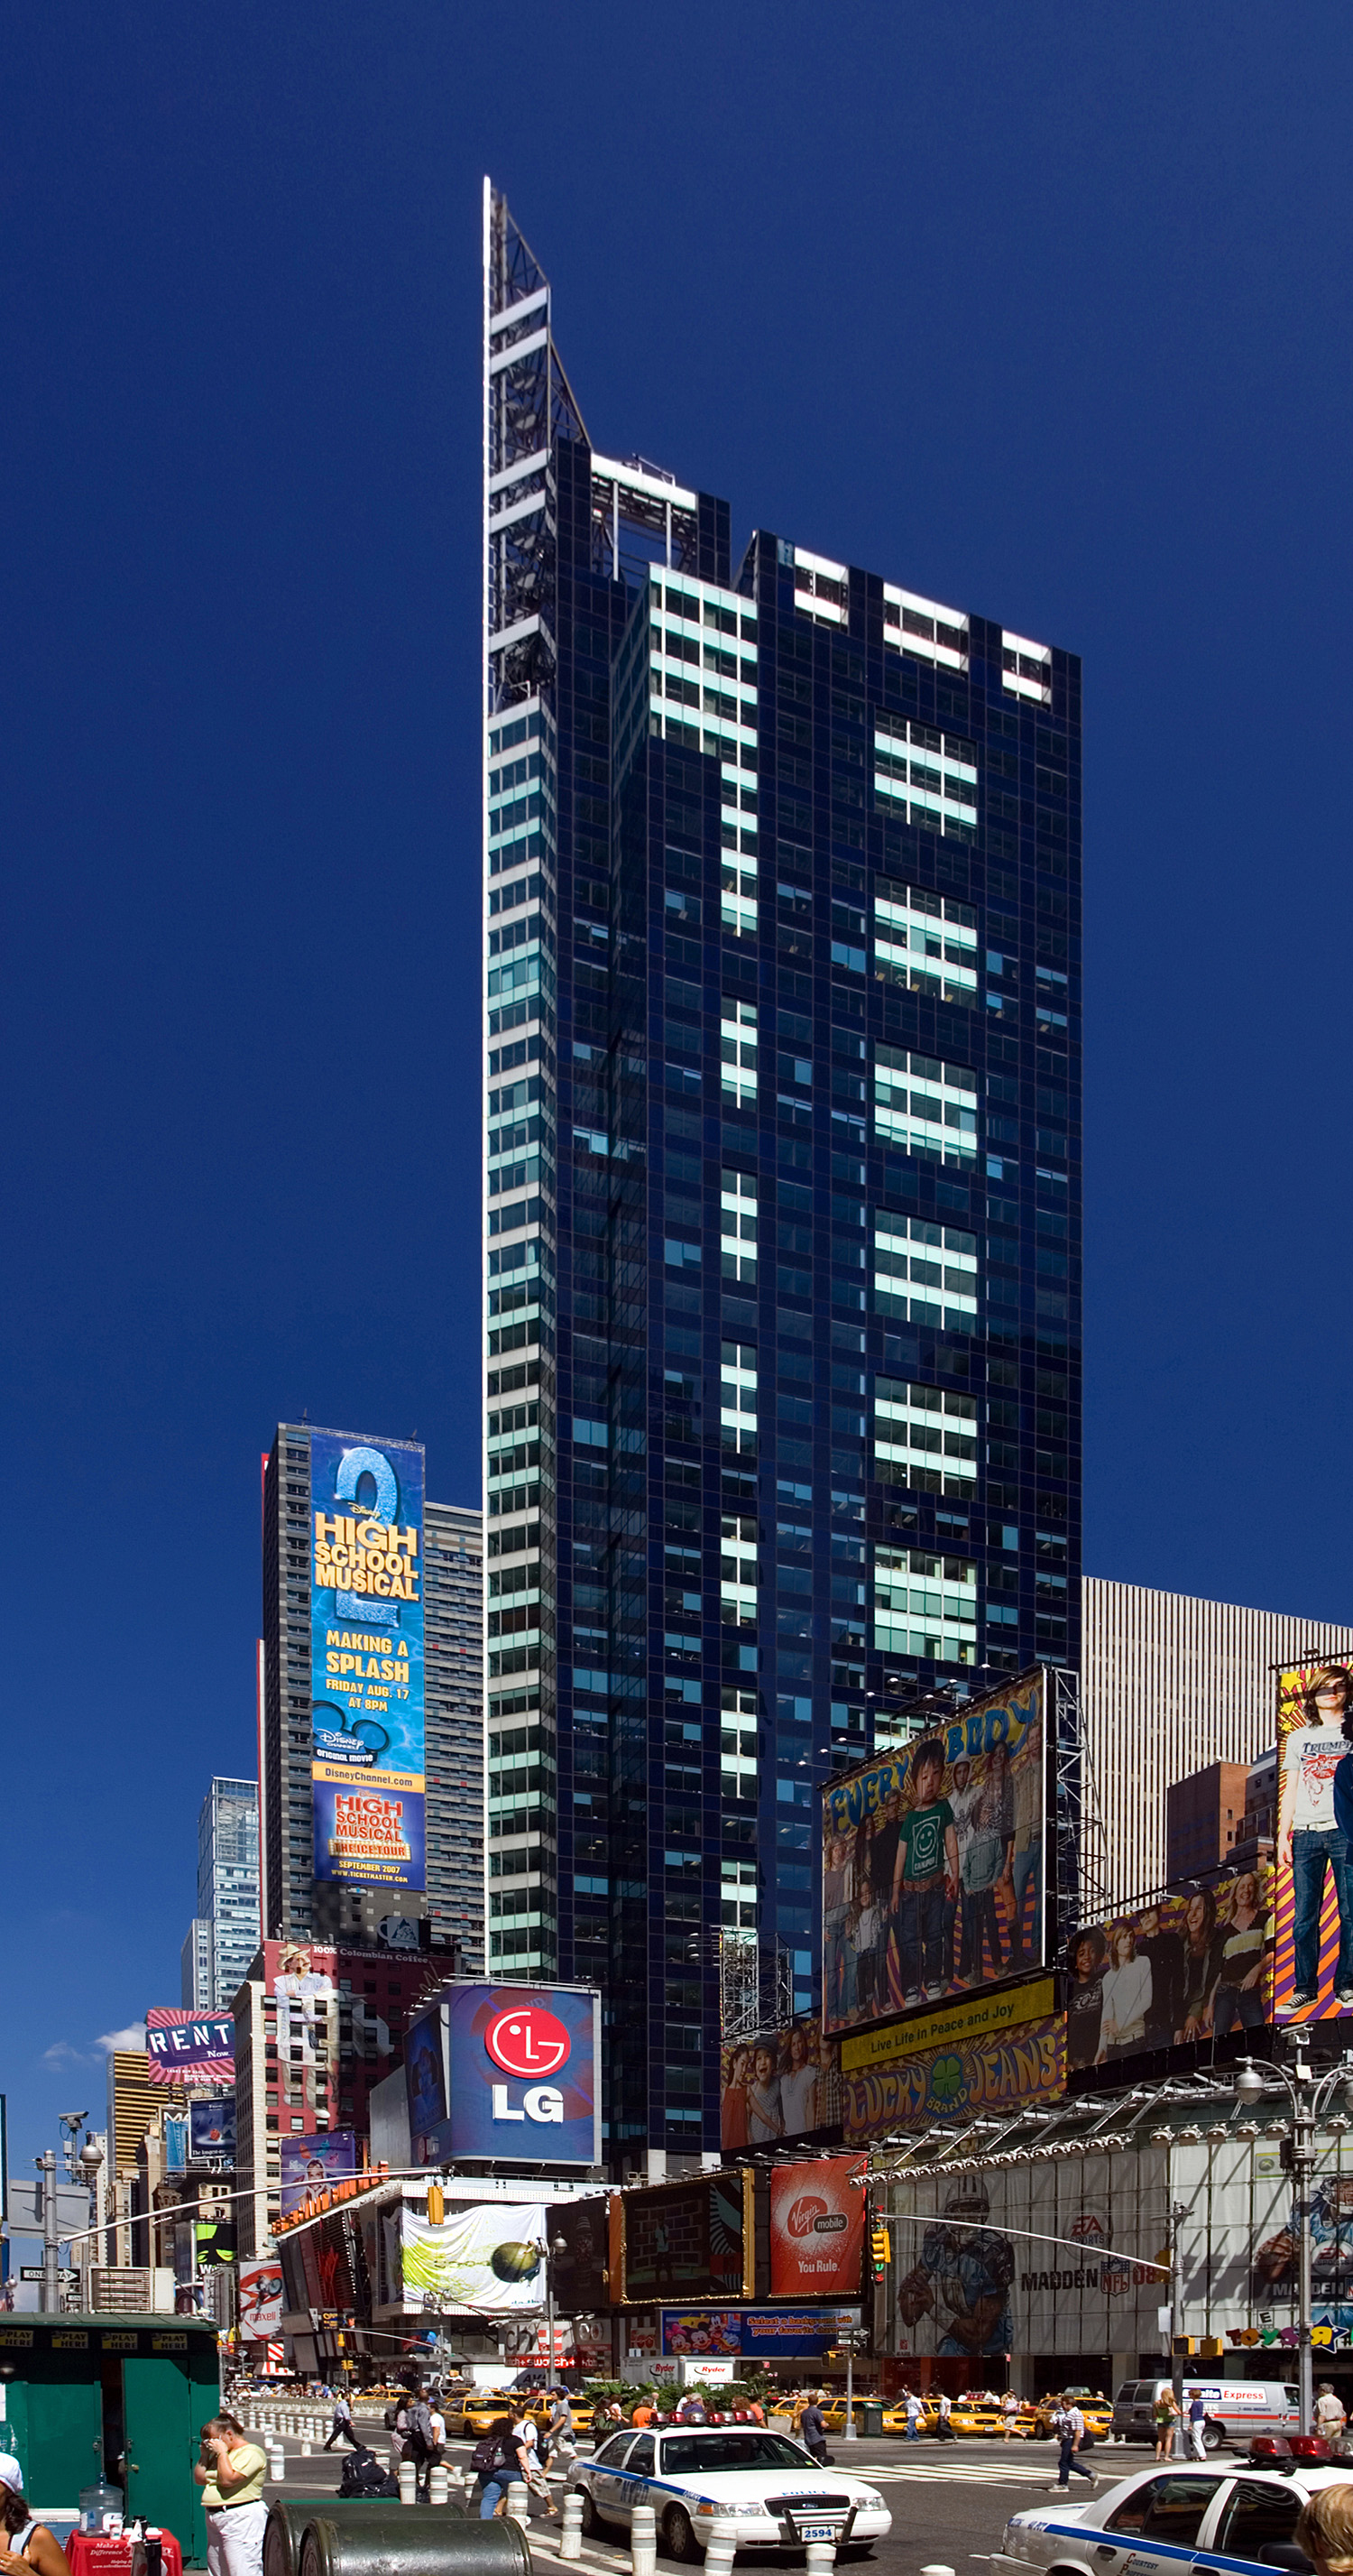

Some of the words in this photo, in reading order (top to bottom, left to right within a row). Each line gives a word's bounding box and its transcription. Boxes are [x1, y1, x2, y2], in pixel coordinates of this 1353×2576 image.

[316, 1511, 418, 1556] HIGH
[314, 1541, 419, 1579] SCHOOL
[316, 1563, 419, 1602] MUSICAL
[326, 1630, 392, 1654] MAKING
[397, 1640, 409, 1657] A
[326, 1651, 410, 1683] SPLASH
[326, 1678, 364, 1694] FRIDAY
[367, 1685, 392, 1698] AUG.
[396, 1689, 410, 1700] 17
[348, 1697, 362, 1708] AT
[364, 1699, 388, 1712] 8PM
[829, 1755, 909, 1835] EVERY
[947, 1689, 1037, 1763] BODY
[325, 1768, 413, 1787] DisneyChannel.com
[335, 1794, 403, 1817] HIGH
[336, 1811, 402, 1830] SCHOOL
[336, 1824, 402, 1842] MUSICAL
[335, 1842, 354, 1853] THE
[356, 1843, 373, 1854] ICE
[376, 1845, 405, 1856] TOUR
[338, 1860, 381, 1872] SEPTEMBER
[382, 1865, 400, 1874] 2007
[331, 1869, 408, 1883] WWW.TICKETMASTER.COM
[313, 1945, 337, 1955] 100%
[340, 1948, 393, 1961] Colombian
[395, 1953, 428, 1964] Coffee
[871, 2037, 892, 2053] Live
[895, 2032, 916, 2050] Life
[916, 2028, 928, 2039] in
[930, 2018, 964, 2036] Peace
[967, 2008, 989, 2026] and
[992, 2004, 1015, 2021] Joy
[149, 2024, 229, 2053] RENT
[847, 2065, 927, 2128] LUCKY
[969, 2034, 1056, 2104] JEANS
[492, 2084, 565, 2123] LG
[926, 2087, 968, 2112] BRAND
[792, 2199, 820, 2233] Virgin
[817, 2218, 843, 2229] mobile
[1071, 2215, 1104, 2236] EA
[1070, 2235, 1105, 2246] SPORTS
[1319, 2248, 1348, 2259] EA
[798, 2260, 815, 2273] You
[816, 2259, 840, 2272] Rule.
[1021, 2268, 1098, 2292] MADDEN
[1102, 2274, 1128, 2292] NFL
[249, 2312, 276, 2322] maxell
[748, 2316, 779, 2326] Select
[788, 2316, 836, 2326] background
[837, 2315, 853, 2324] with
[7, 2330, 32, 2339] PLAY
[61, 2331, 87, 2341] PLAY
[112, 2333, 136, 2341] PLAY
[161, 2333, 186, 2342] PLAY
[752, 2327, 777, 2337] your
[778, 2326, 815, 2335] favorite
[1226, 2326, 1300, 2346] TOYS
[5, 2339, 31, 2347] HERE
[111, 2341, 135, 2350] HERE
[161, 2341, 185, 2350] HERE
[656, 2364, 675, 2373] Ryder
[702, 2366, 726, 2375] Ryder
[1223, 2390, 1264, 2400] Express
[621, 2480, 649, 2505] NYPD
[683, 2490, 702, 2502] POLICE
[805, 2529, 832, 2538] 2594
[1127, 2553, 1159, 2570] COURTESY
